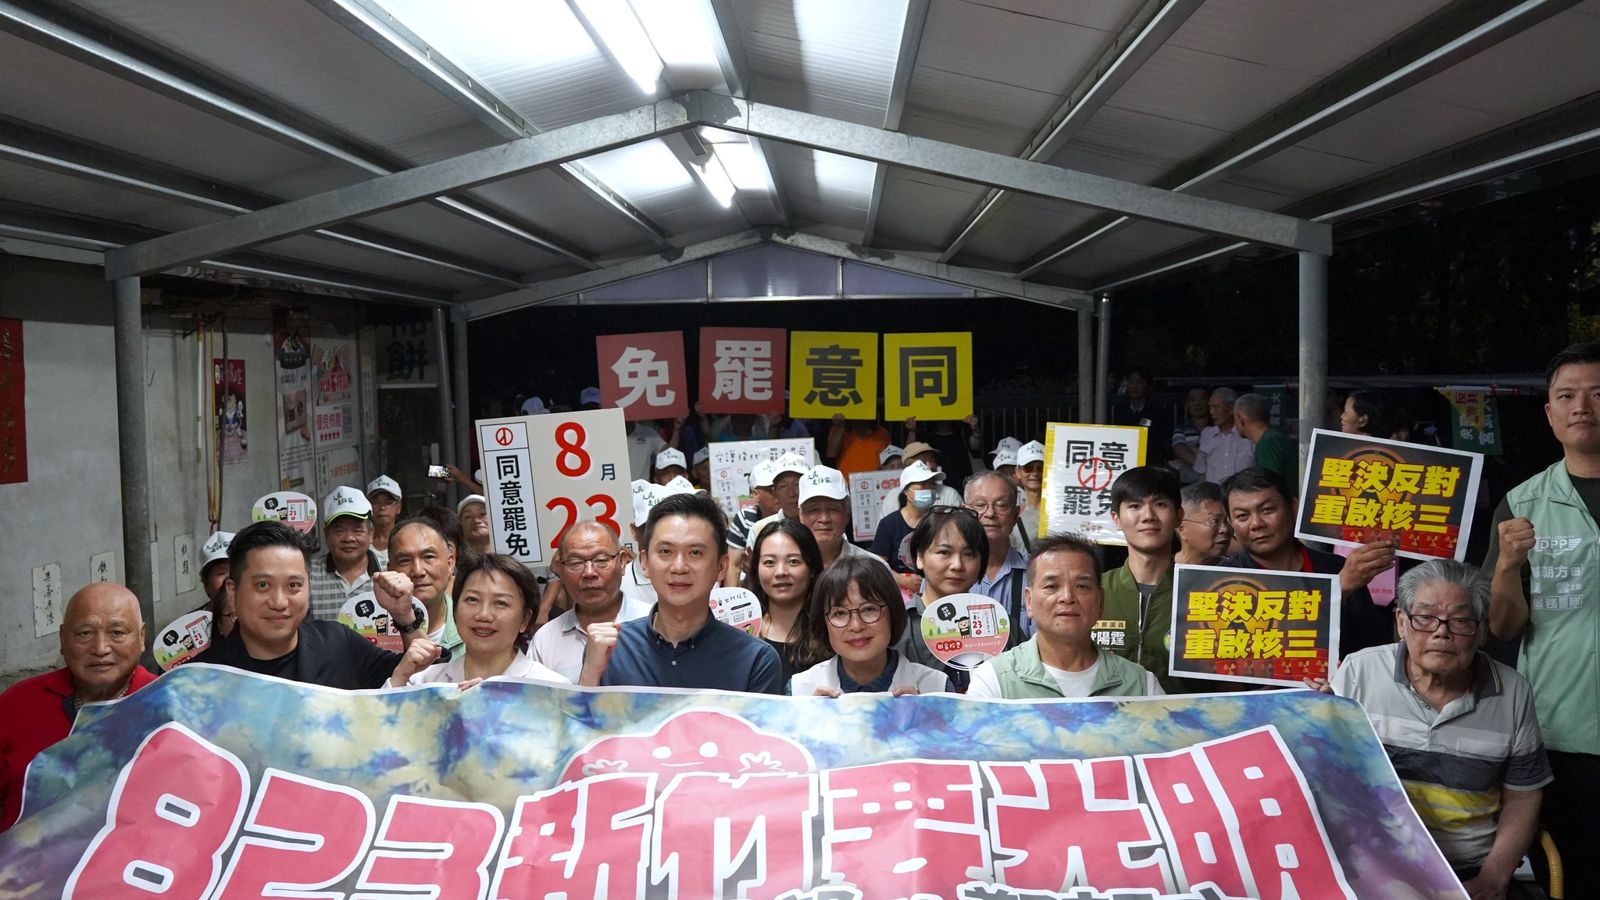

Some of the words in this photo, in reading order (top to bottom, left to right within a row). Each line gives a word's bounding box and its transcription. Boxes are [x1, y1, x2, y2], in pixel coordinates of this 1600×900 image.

[611, 346, 676, 408] 免
[712, 340, 773, 401] 罷
[804, 344, 864, 407] 意
[899, 346, 957, 408] 同
[1065, 440, 1129, 470] 同意
[1318, 457, 1461, 498] 堅決反對
[495, 453, 532, 557] 同意罷免
[1310, 494, 1451, 534] 重啟核三
[1540, 539, 1569, 549] DPP
[1186, 590, 1322, 622] 堅決反對
[1183, 629, 1318, 660] 重啟核三
